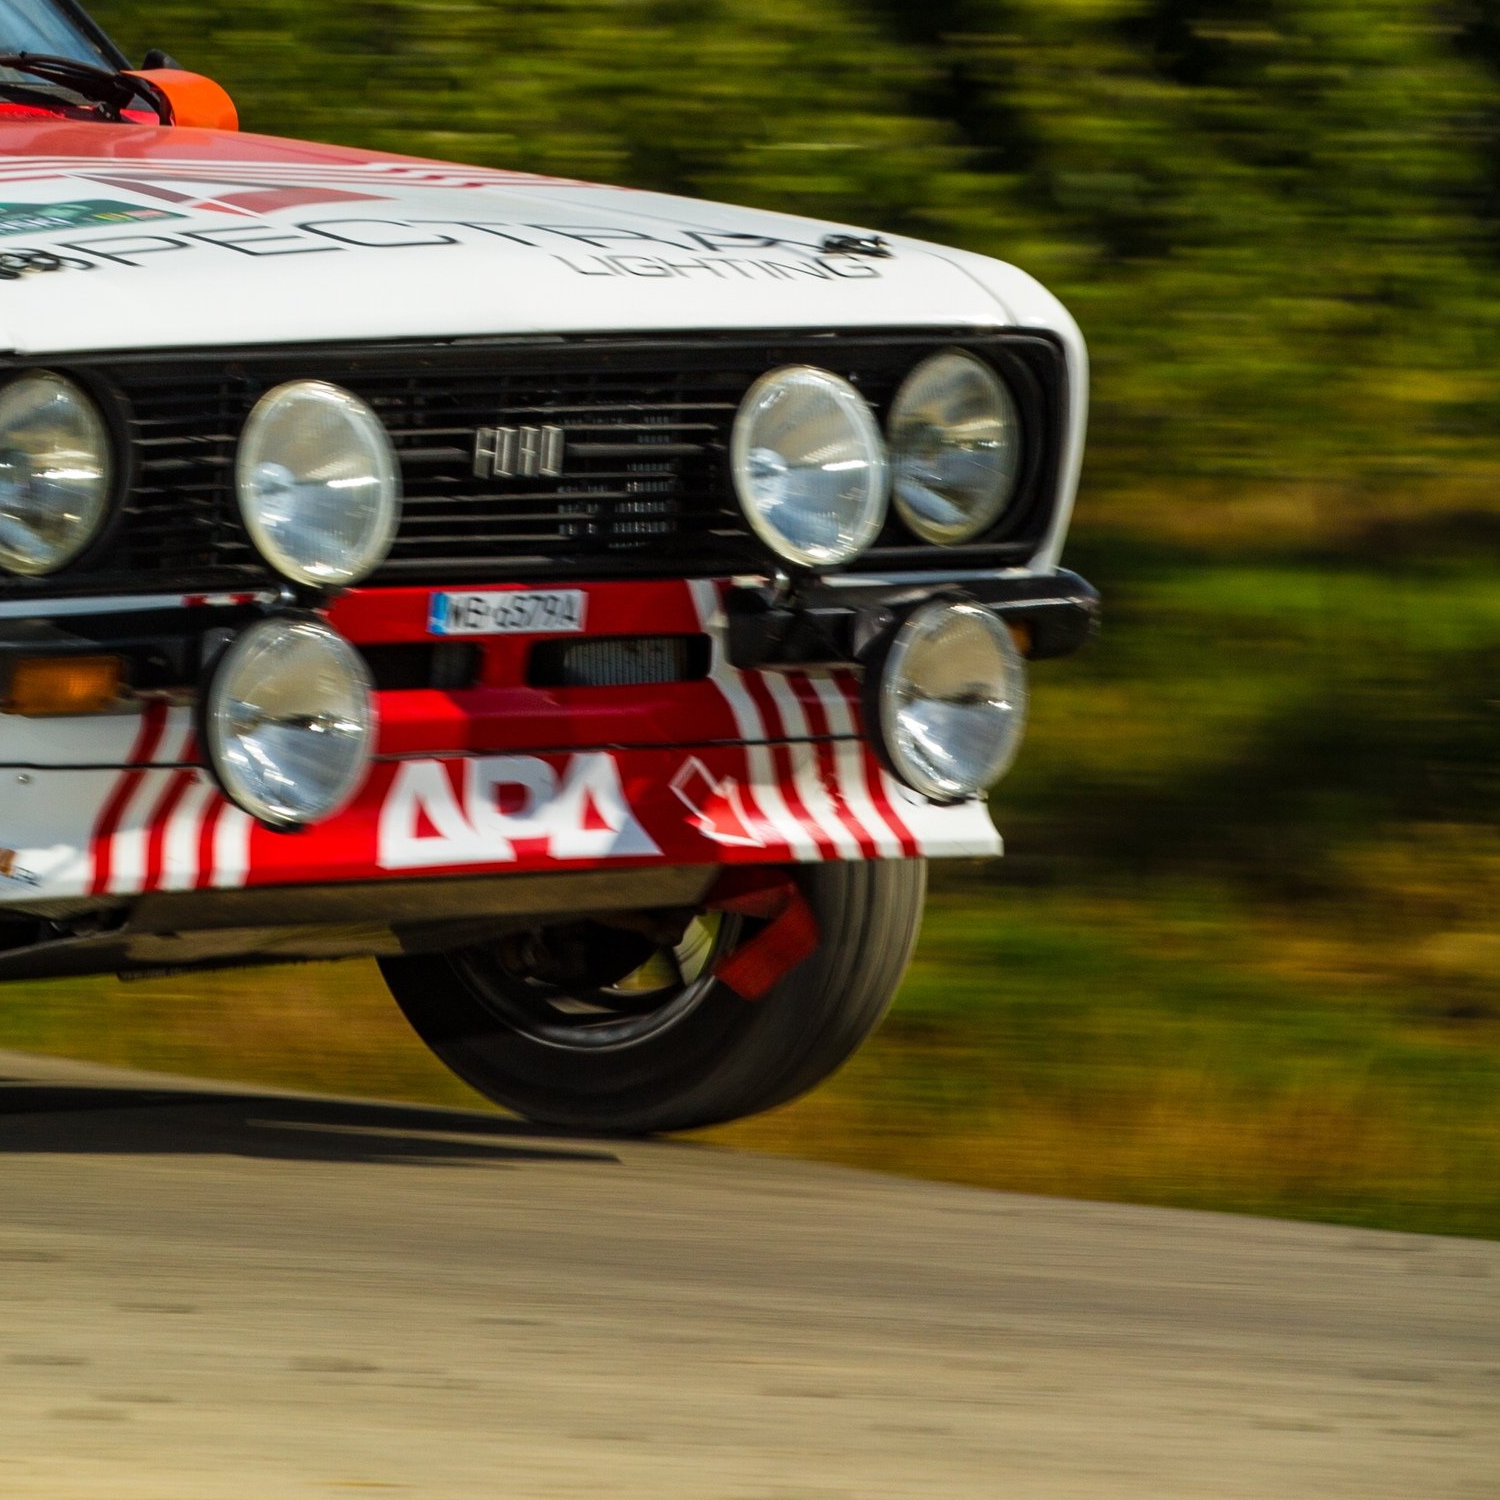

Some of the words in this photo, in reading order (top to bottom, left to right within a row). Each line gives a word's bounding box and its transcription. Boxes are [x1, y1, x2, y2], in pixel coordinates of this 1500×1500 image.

[553, 252, 882, 281] LIGHTING
[450, 596, 486, 629] WB
[376, 752, 664, 871] APA
